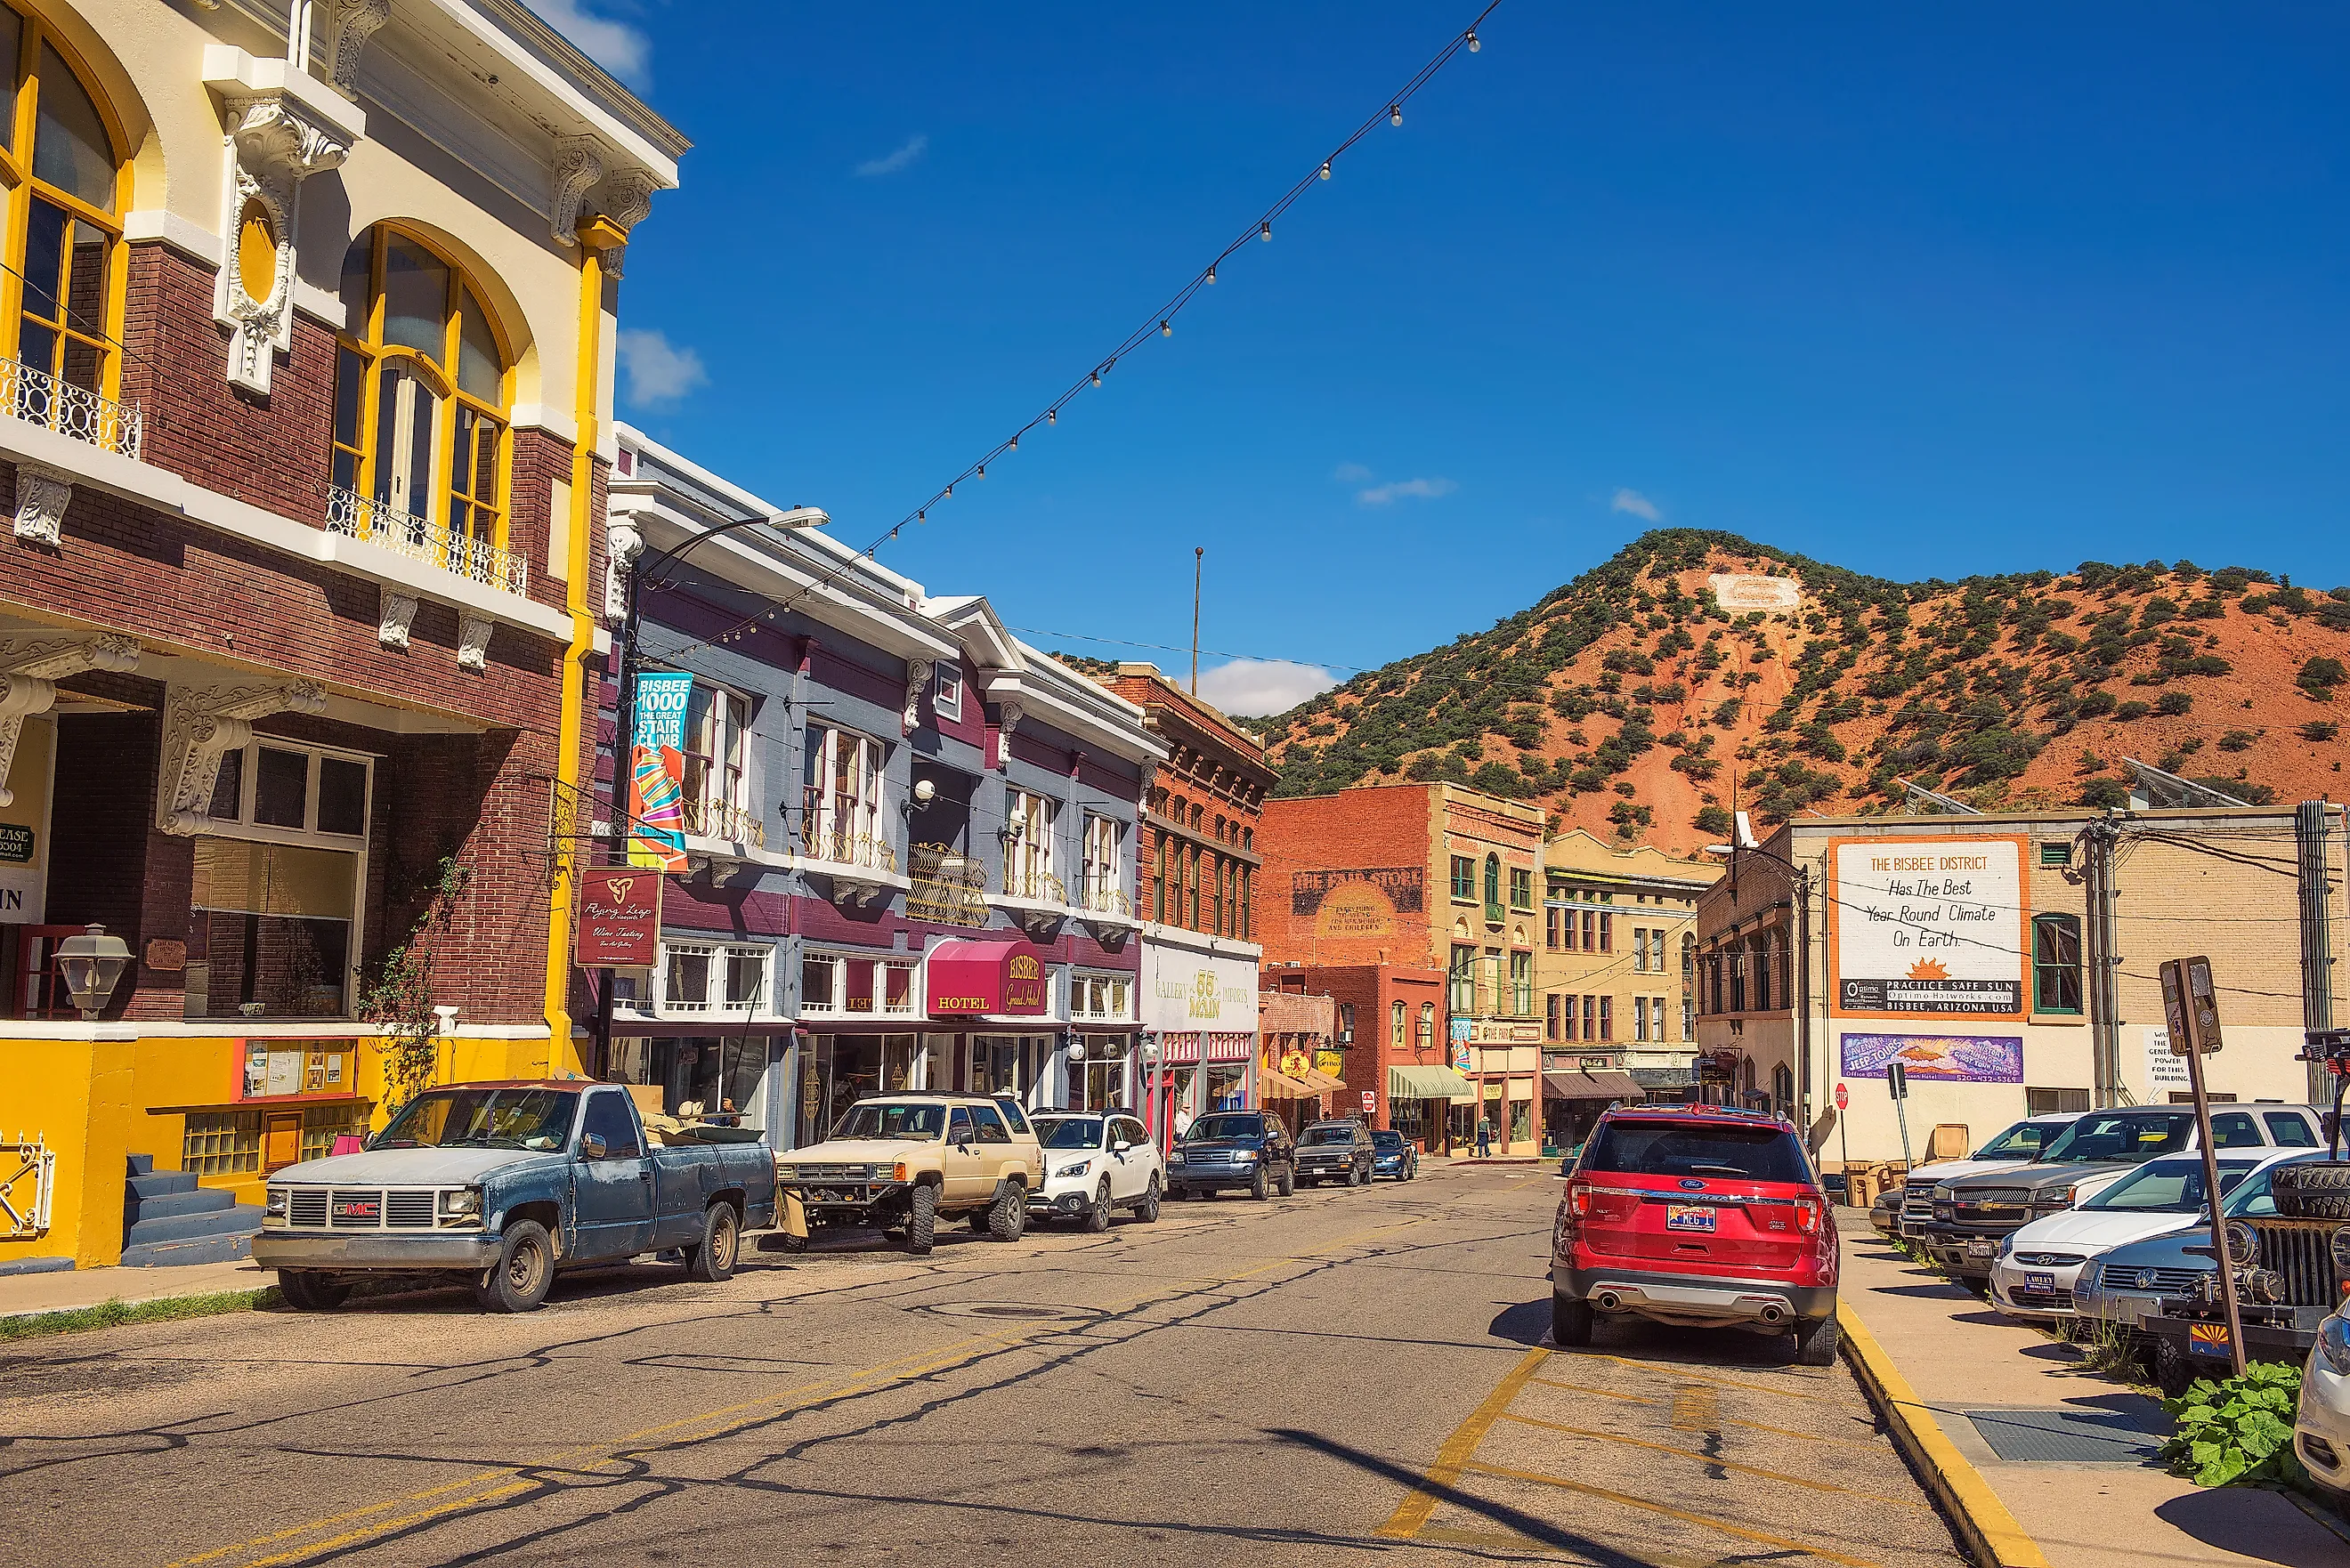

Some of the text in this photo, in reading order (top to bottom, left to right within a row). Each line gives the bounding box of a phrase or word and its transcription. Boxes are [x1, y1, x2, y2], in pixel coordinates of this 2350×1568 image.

[640, 679, 691, 692] BISBEE
[638, 691, 686, 711] 1000
[640, 711, 682, 720] THE GREAT
[638, 719, 680, 734] STAIR
[637, 733, 679, 748] CLIMB
[1871, 856, 1987, 871] THE BISBEE DISTRICT
[1888, 878, 1972, 895] Has The Best
[585, 902, 652, 920] Flying Leap
[1867, 905, 1997, 922] Year Round Climate
[592, 926, 644, 942] Wine Tasting
[1893, 930, 1961, 948] On Earth.
[1009, 954, 1040, 981] BISBEE
[1155, 982, 1248, 1004] GALLERY IMPORTS
[1886, 981, 2014, 991] PRACTICE SAFE SUN
[245, 1004, 264, 1014] OPEN
[937, 997, 990, 1010] HOTEL
[1886, 1002, 2014, 1013] BISBEE, ARIZONA USA
[1845, 1037, 1884, 1057] LAVENDER
[1849, 1038, 1902, 1071] JEEP TOURS
[1977, 1044, 2007, 1059] HISTORY
[1954, 1051, 2013, 1075] GHOST TOWN TOURS
[1967, 1048, 1993, 1063] MINING
[1957, 1074, 2016, 1083] 520-432-5369
[2154, 1074, 2190, 1082] BUILDING.
[1835, 1091, 1848, 1103] STOP
[1684, 1180, 1701, 1188] Ford
[333, 1203, 378, 1216] GMC
[1682, 1213, 1710, 1225] MEG 1
[2026, 1275, 2054, 1285] LAWLEY
